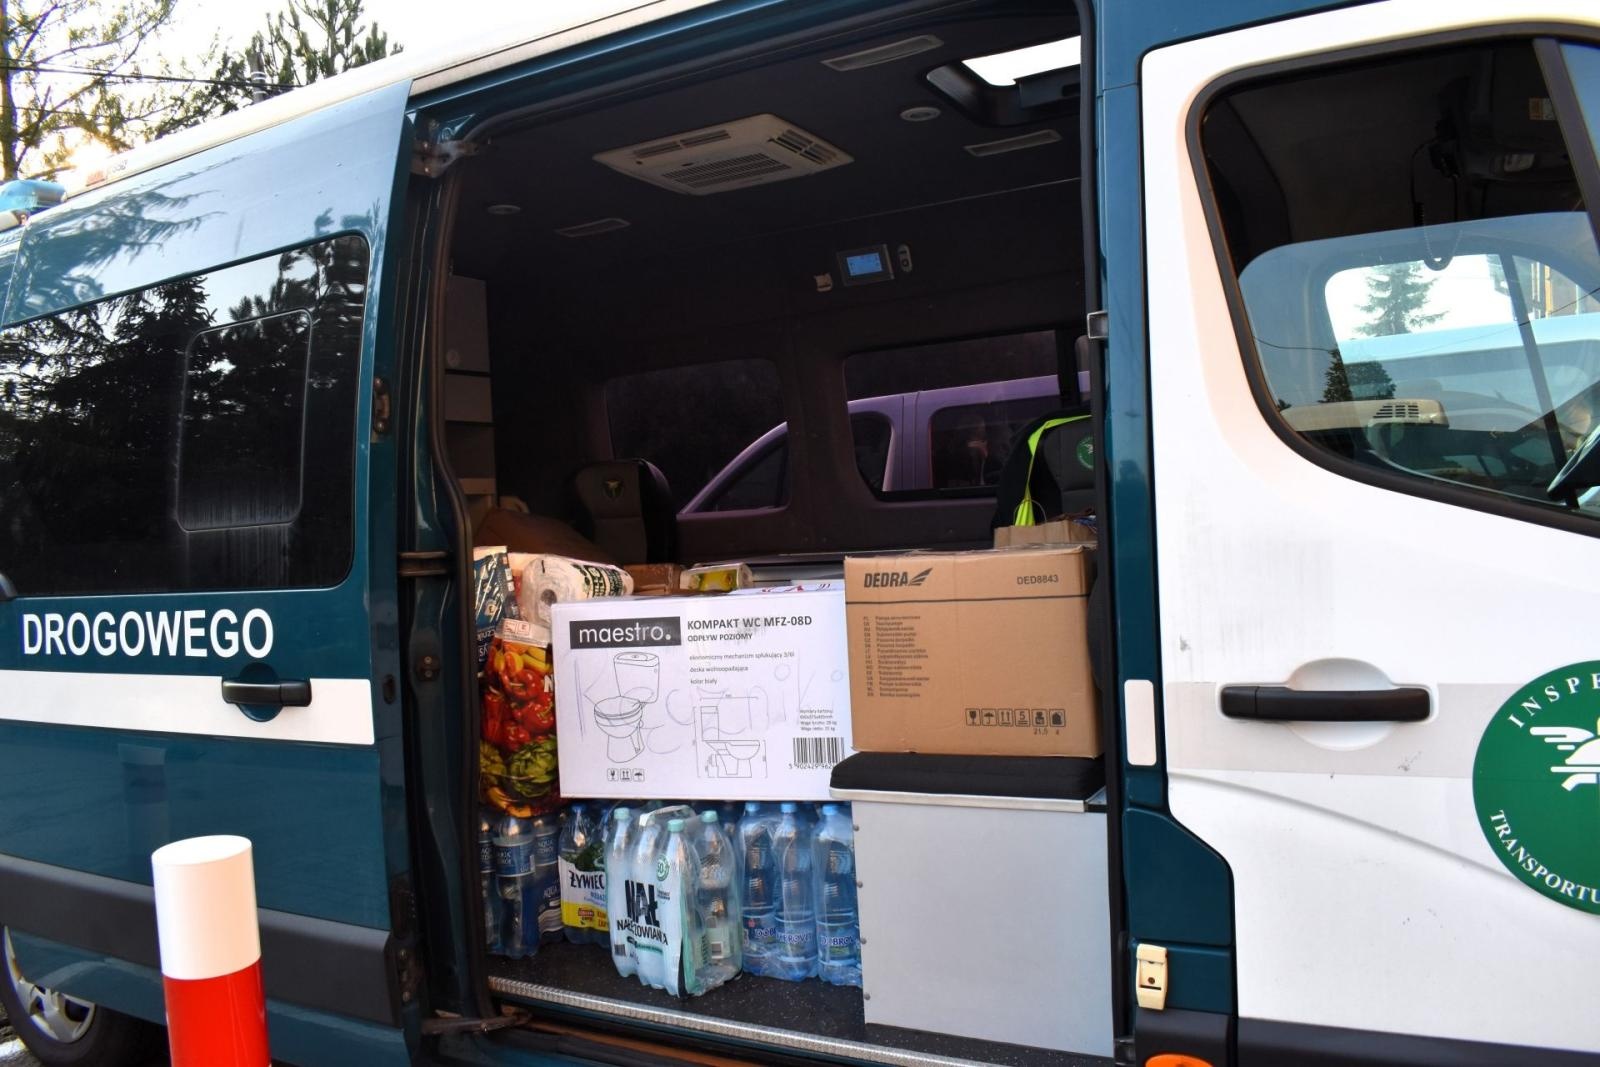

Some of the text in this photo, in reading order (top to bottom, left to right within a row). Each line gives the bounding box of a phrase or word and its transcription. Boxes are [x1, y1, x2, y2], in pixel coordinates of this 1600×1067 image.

[864, 572, 908, 588] DEDRA
[1017, 574, 1059, 585] DED8843
[687, 615, 812, 630] KOMPAKT WC MFZ-08D
[21, 608, 274, 658] DROGOWEGO
[687, 632, 753, 642] ODPŁYW POZIOMY
[568, 869, 605, 890] ŻYWIEC
